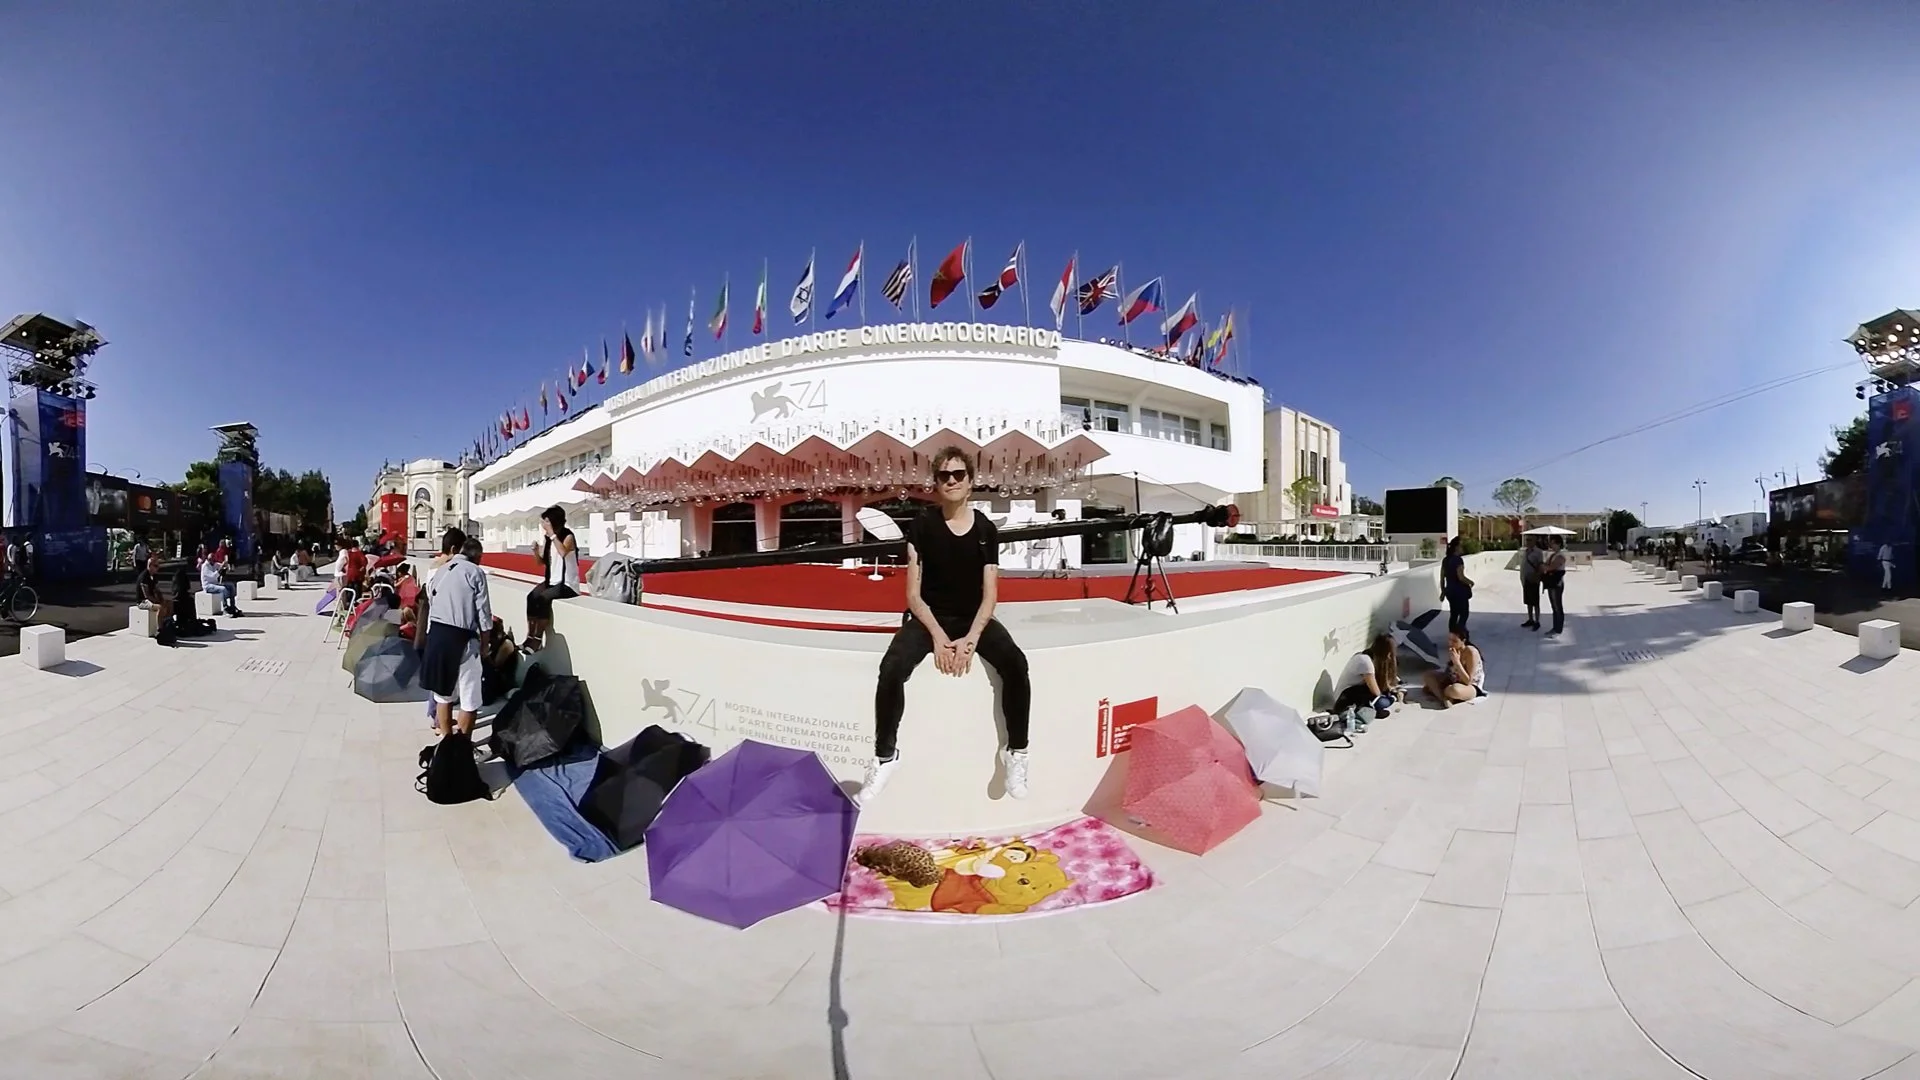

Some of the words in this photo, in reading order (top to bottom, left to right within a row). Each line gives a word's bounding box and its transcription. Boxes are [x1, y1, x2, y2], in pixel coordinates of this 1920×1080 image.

[781, 329, 848, 356] D'ARTE
[861, 322, 1062, 349] CINEMATOGRAFICA
[724, 701, 763, 716] MOSTRA
[766, 710, 860, 732] INTERNAZIONALE
[738, 727, 787, 744] BIENNALE
[804, 740, 851, 754] VENEZIA
[776, 723, 877, 745] CINEMATOGRAFIC
